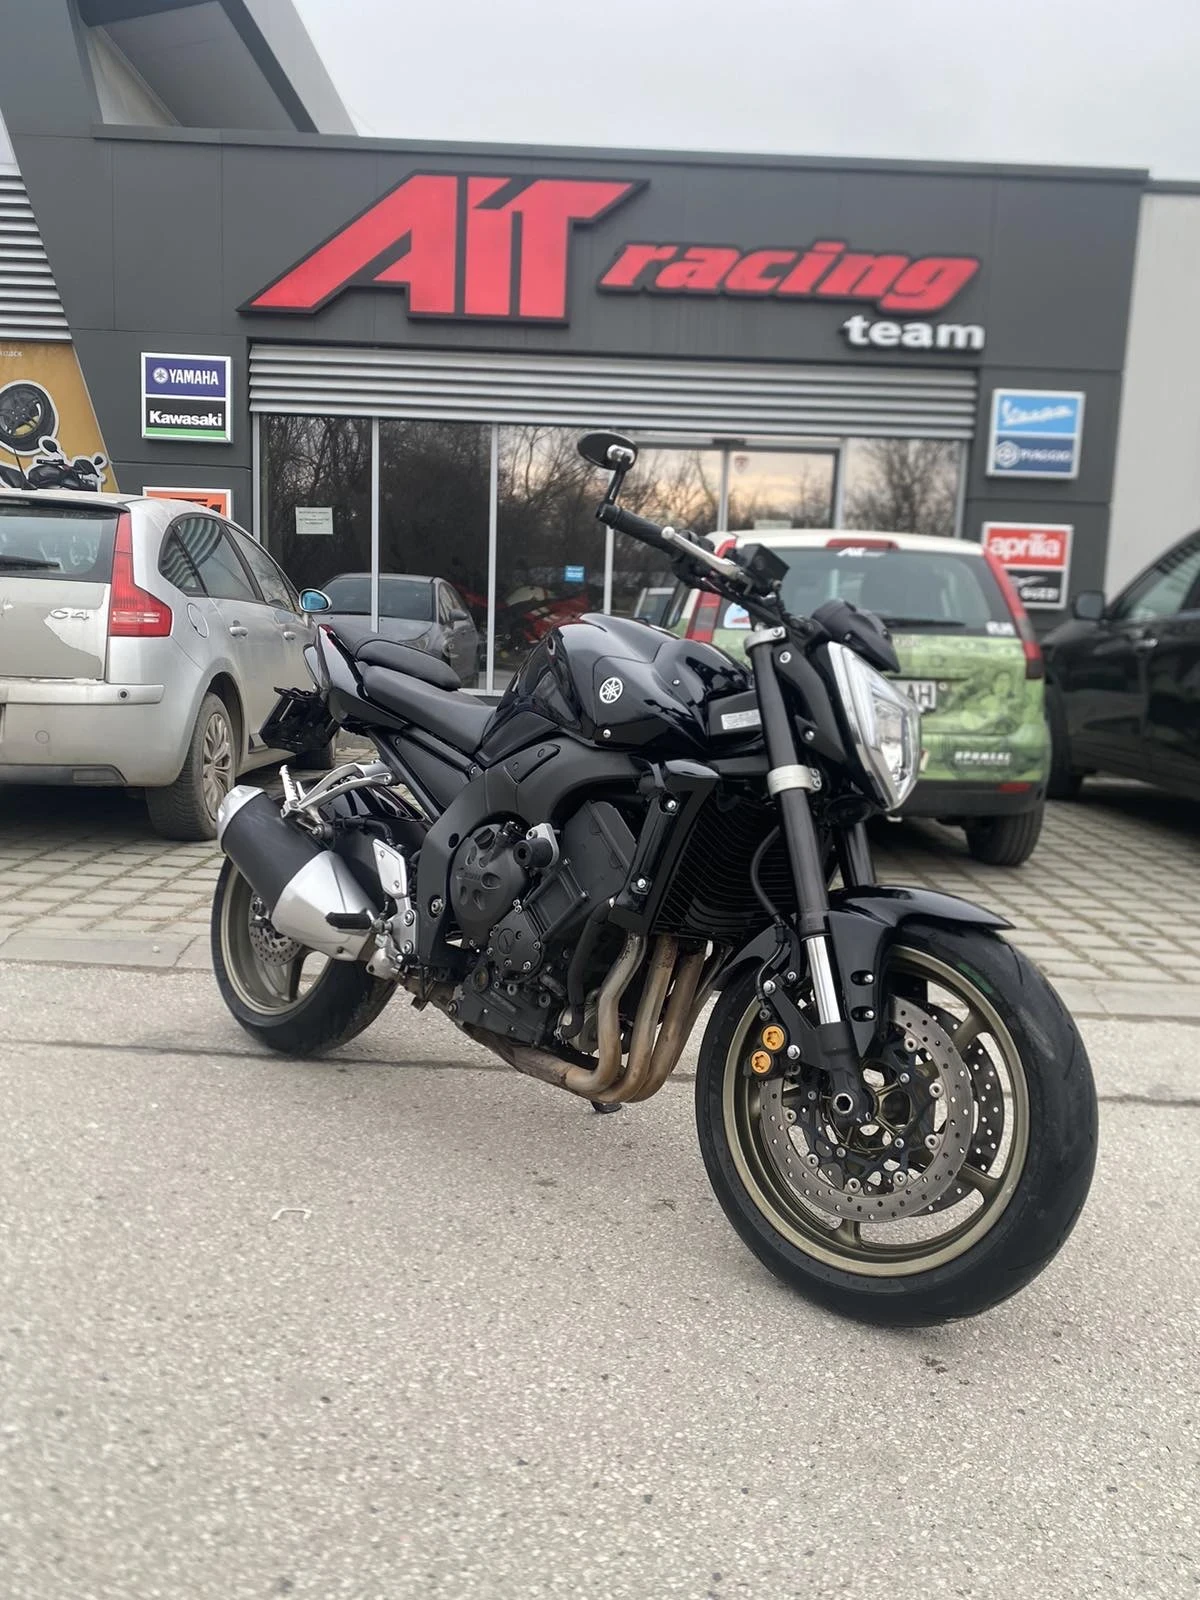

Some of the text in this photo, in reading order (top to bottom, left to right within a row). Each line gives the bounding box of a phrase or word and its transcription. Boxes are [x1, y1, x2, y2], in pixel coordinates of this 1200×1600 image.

[600, 241, 980, 311] racing
[843, 315, 985, 351] team
[168, 368, 219, 386] YAMAHA
[149, 410, 223, 427] Kawasaki
[49, 604, 90, 621] C4
